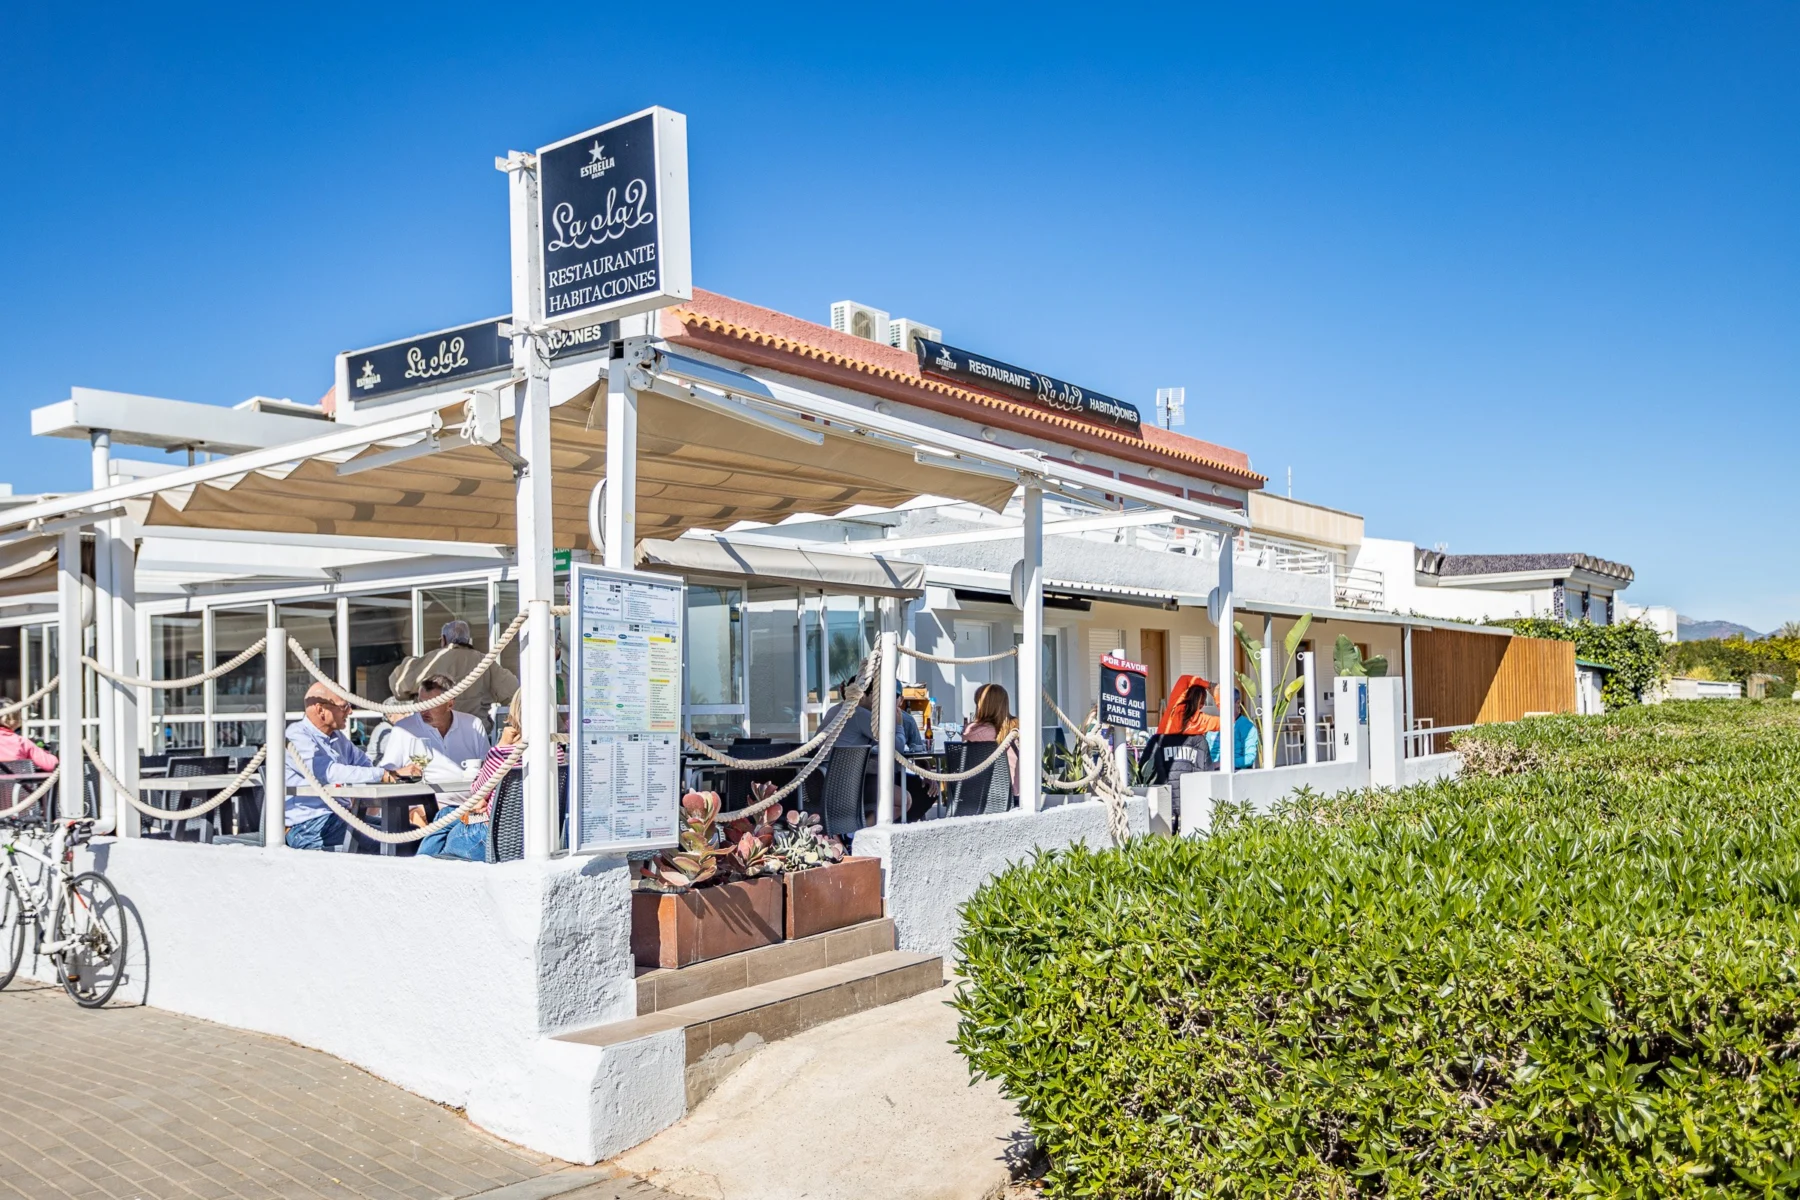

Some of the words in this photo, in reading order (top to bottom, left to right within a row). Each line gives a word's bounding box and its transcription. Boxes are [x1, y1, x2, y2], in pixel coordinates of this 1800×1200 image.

[580, 157, 615, 178] ESTRELLA
[548, 202, 587, 252] La
[548, 243, 656, 288] RESTAURANTE
[549, 270, 656, 313] HABITACIONES
[404, 346, 426, 379] La
[968, 359, 1031, 390] RESTAURANTE
[1038, 375, 1056, 401] La
[1089, 397, 1138, 423] HABITACIONES
[1103, 655, 1118, 666] POR
[1120, 660, 1146, 672] FAVOR
[1102, 693, 1127, 705] ESPERE
[1106, 704, 1126, 715] PARA
[1127, 709, 1141, 719] SER
[1106, 714, 1141, 728] ATENDIDO
[1164, 747, 1197, 763] PUMA
